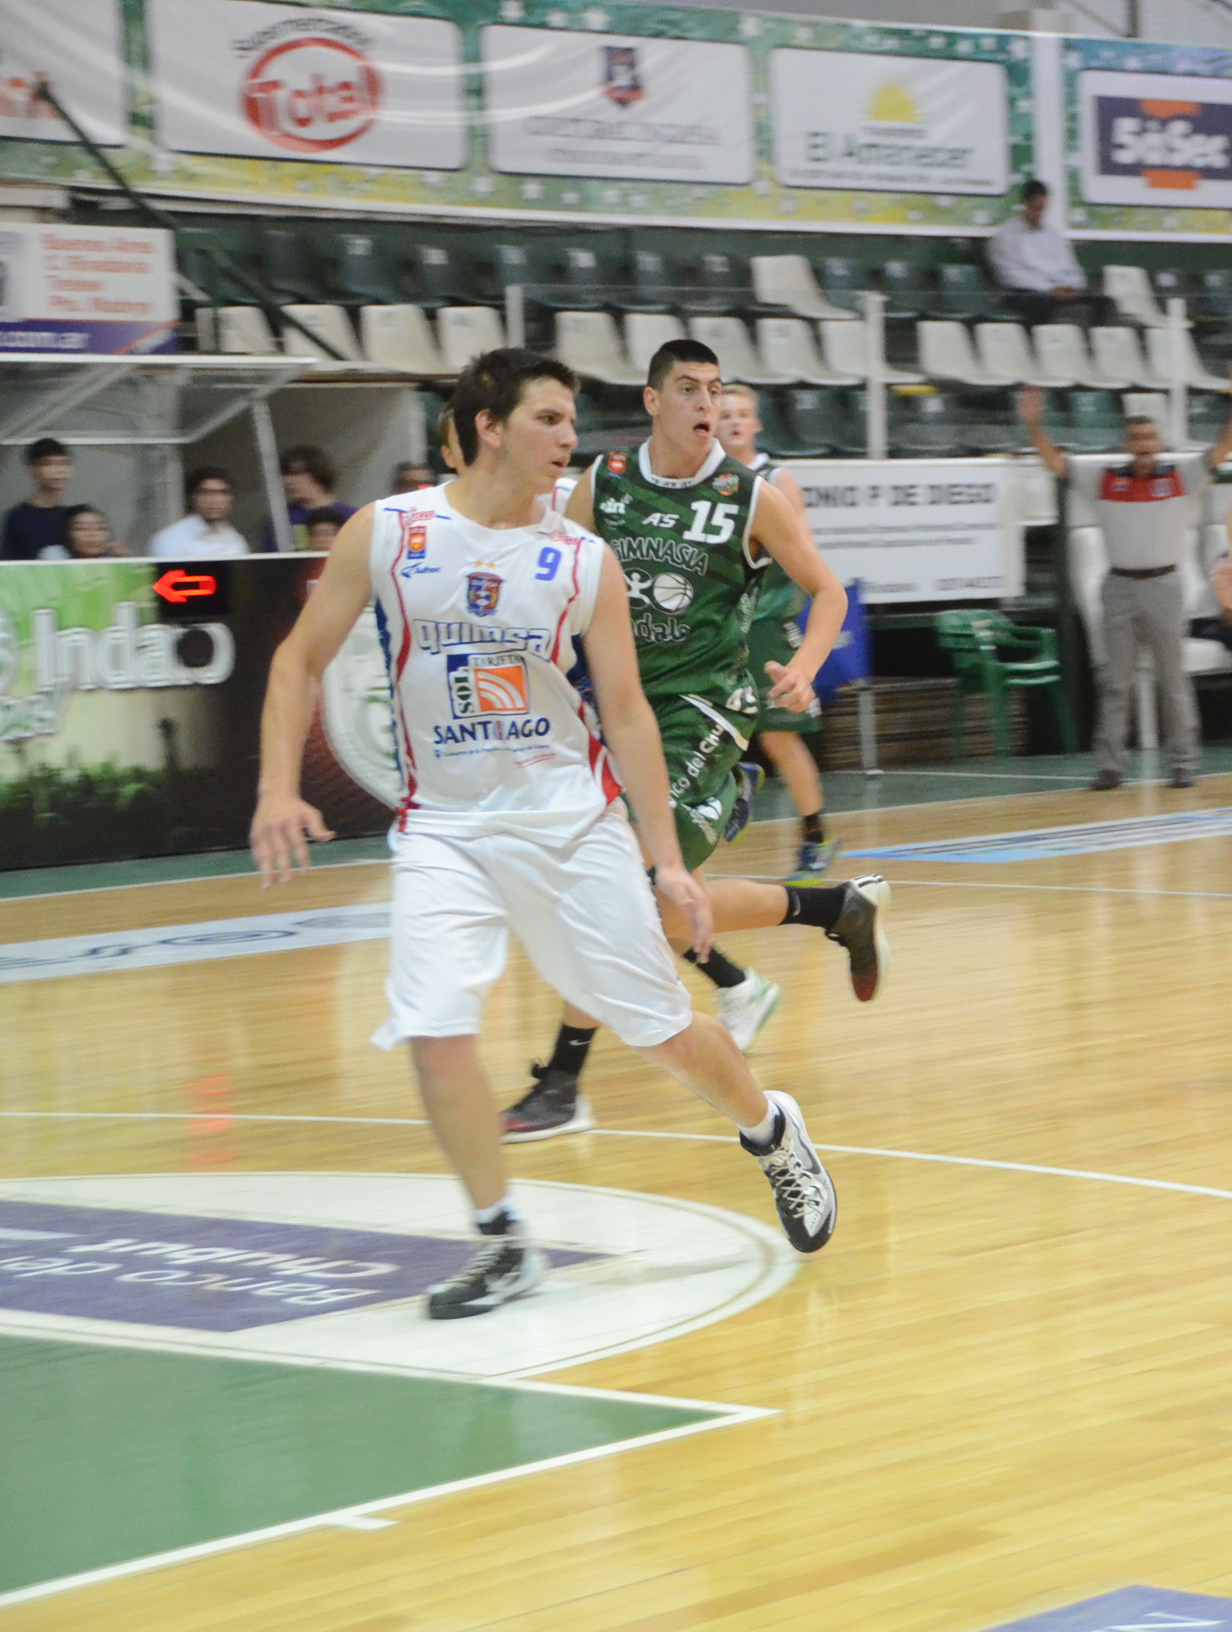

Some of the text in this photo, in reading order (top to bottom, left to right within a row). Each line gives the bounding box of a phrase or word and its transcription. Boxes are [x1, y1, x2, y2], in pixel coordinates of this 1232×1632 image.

[641, 512, 681, 529] AS
[682, 500, 740, 545] 15
[535, 546, 563, 581] 9
[414, 619, 551, 662] quimsa
[433, 717, 551, 746] SANTIAGO
[63, 1237, 402, 1278] Chubut
[114, 1269, 383, 1305] Banco
